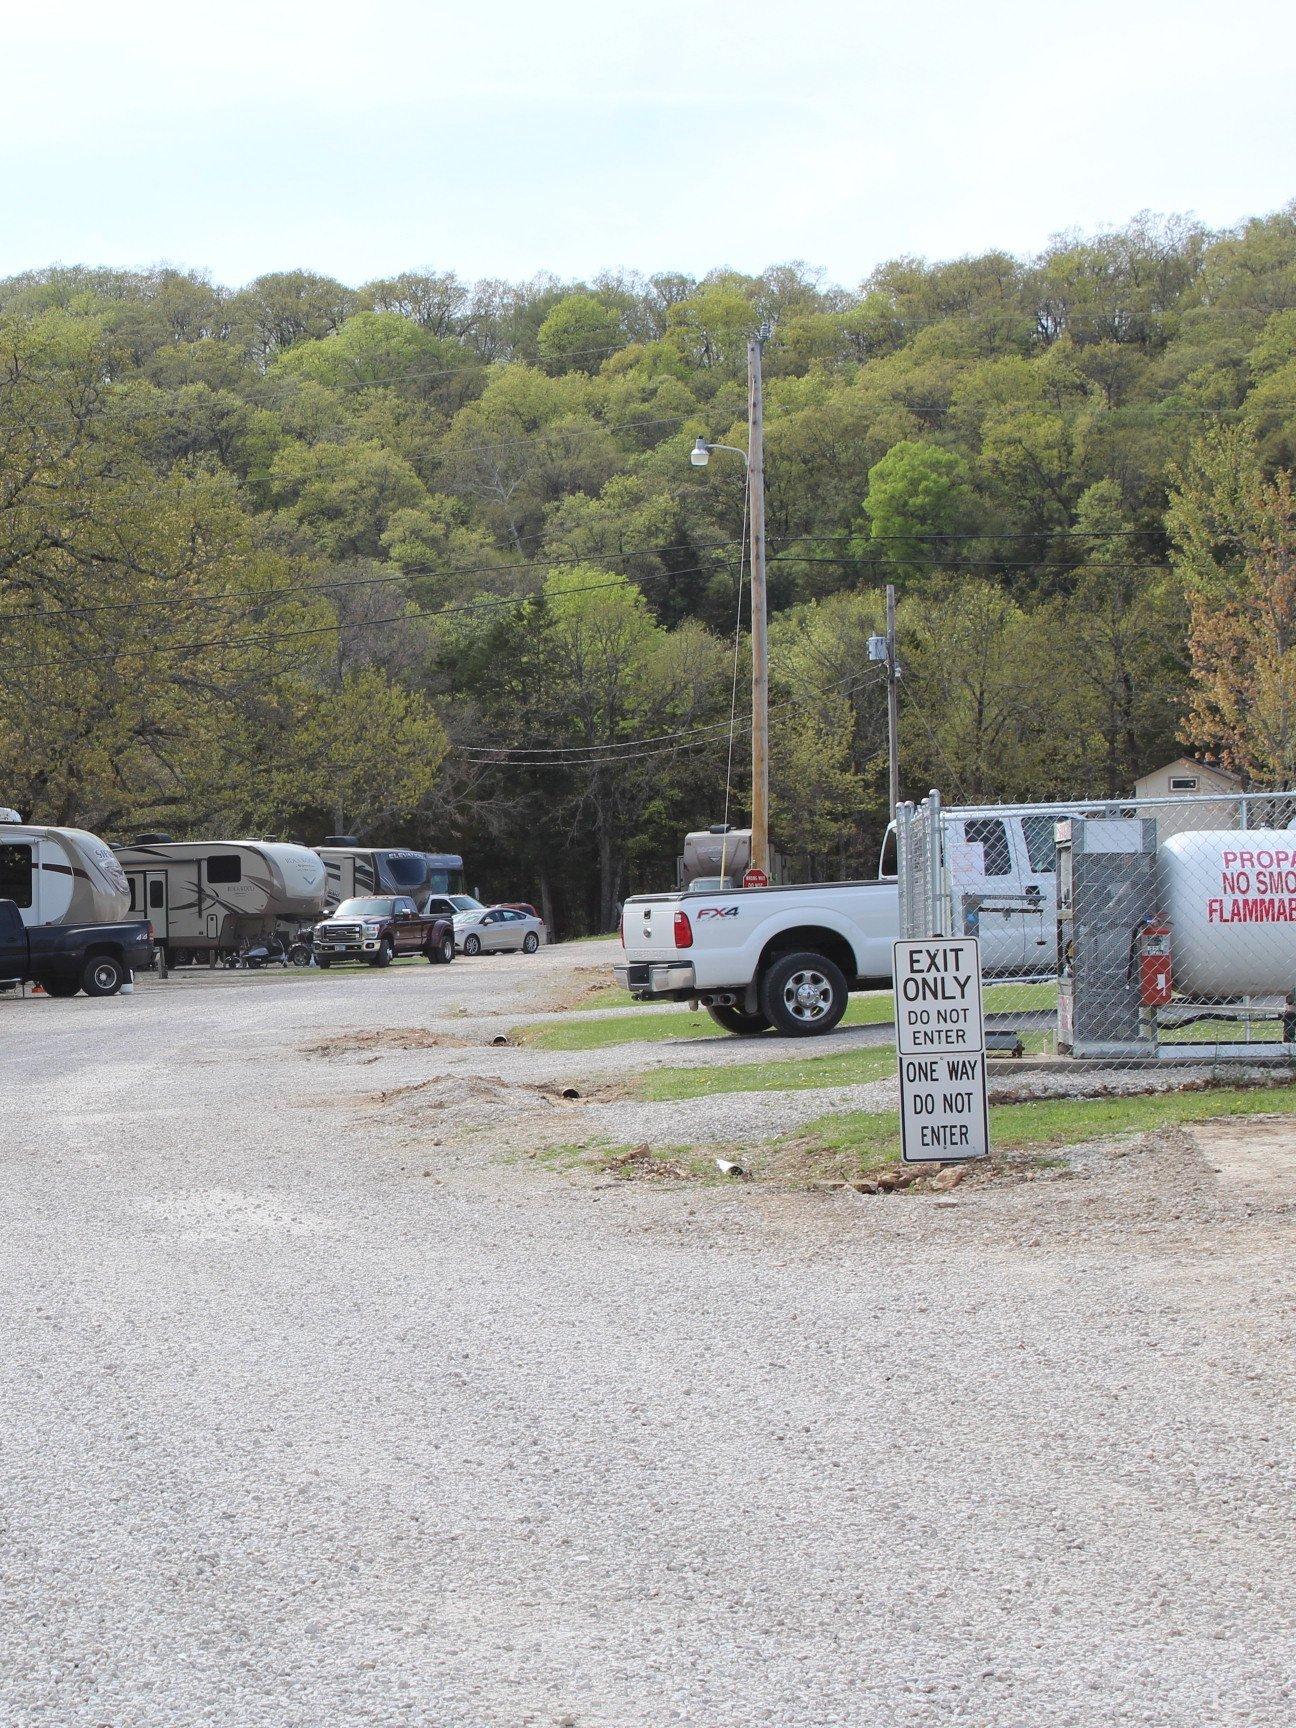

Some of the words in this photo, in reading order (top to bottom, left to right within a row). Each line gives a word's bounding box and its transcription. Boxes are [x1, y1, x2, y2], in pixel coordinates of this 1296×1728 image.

[1222, 871, 1250, 894] NO
[697, 906, 739, 919] FX4
[909, 948, 964, 973] EXIT
[903, 975, 971, 1001] ONLY
[908, 1010, 930, 1025] DO
[937, 1008, 969, 1024] NOT
[913, 1029, 966, 1045] ENTER
[906, 1061, 939, 1082] ONE
[947, 1060, 978, 1081] WAY
[914, 1093, 935, 1114] DO
[943, 1092, 973, 1113] NOT
[921, 1125, 969, 1146] ENTER
